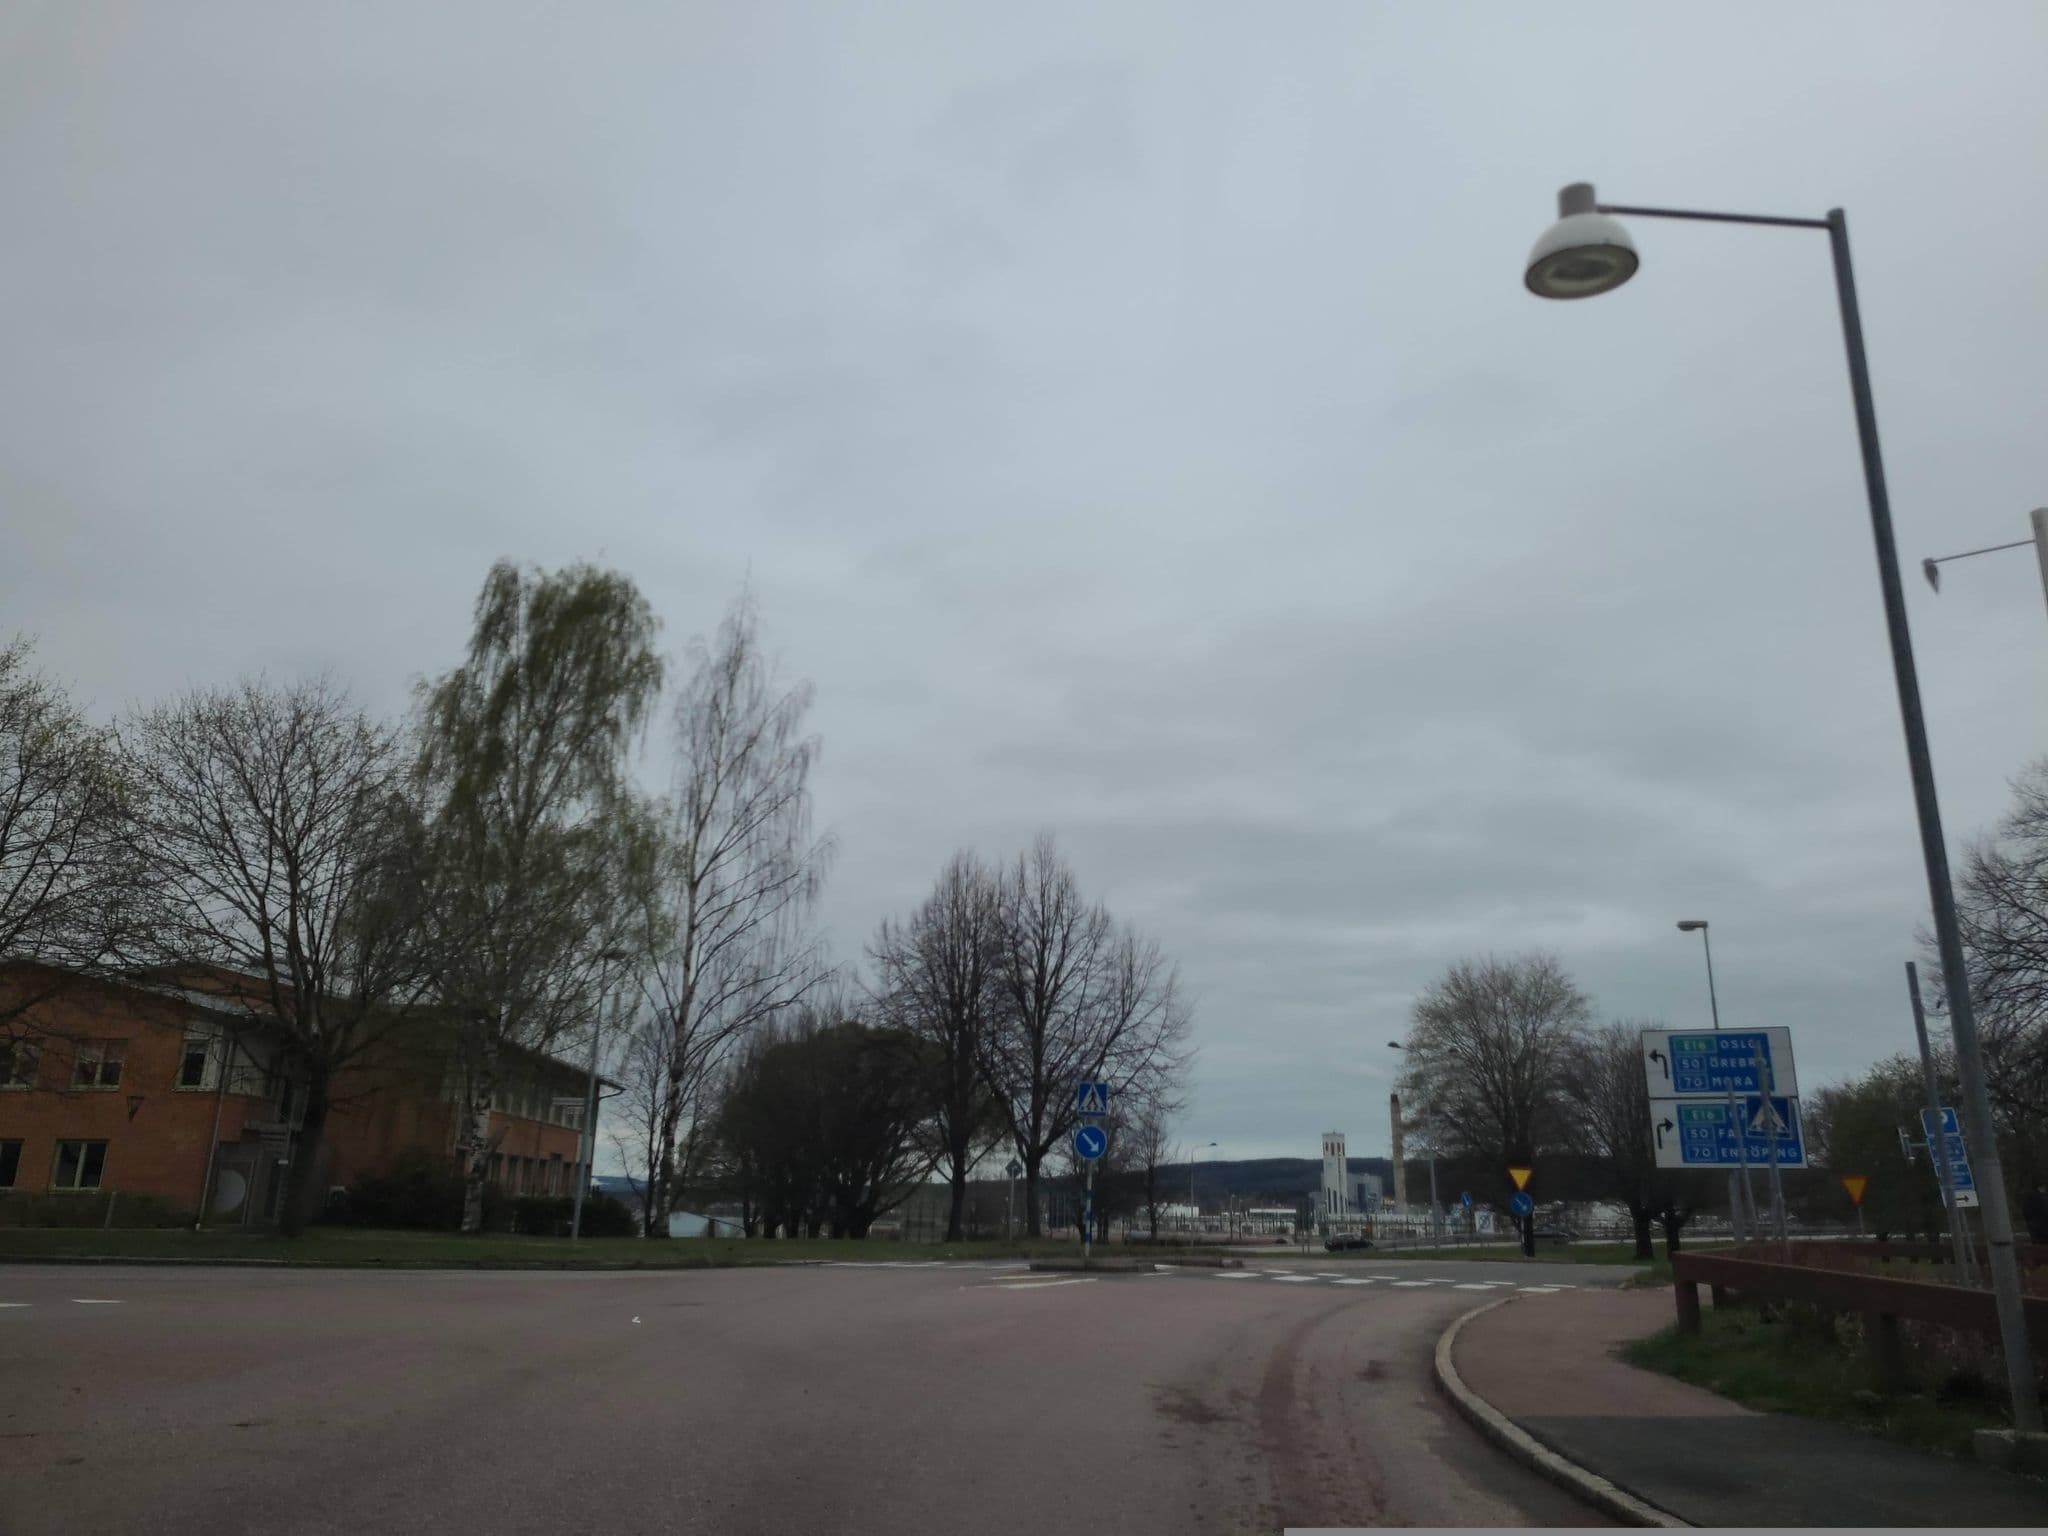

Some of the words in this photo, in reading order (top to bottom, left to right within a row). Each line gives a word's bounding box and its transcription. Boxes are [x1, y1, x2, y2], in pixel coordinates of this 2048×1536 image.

[1681, 1058, 1700, 1069] 50
[1684, 1077, 1703, 1087] 70
[1690, 1128, 1709, 1138] 50
[1693, 1148, 1711, 1158] 70
[1720, 1145, 1798, 1158] ENÖPNG
